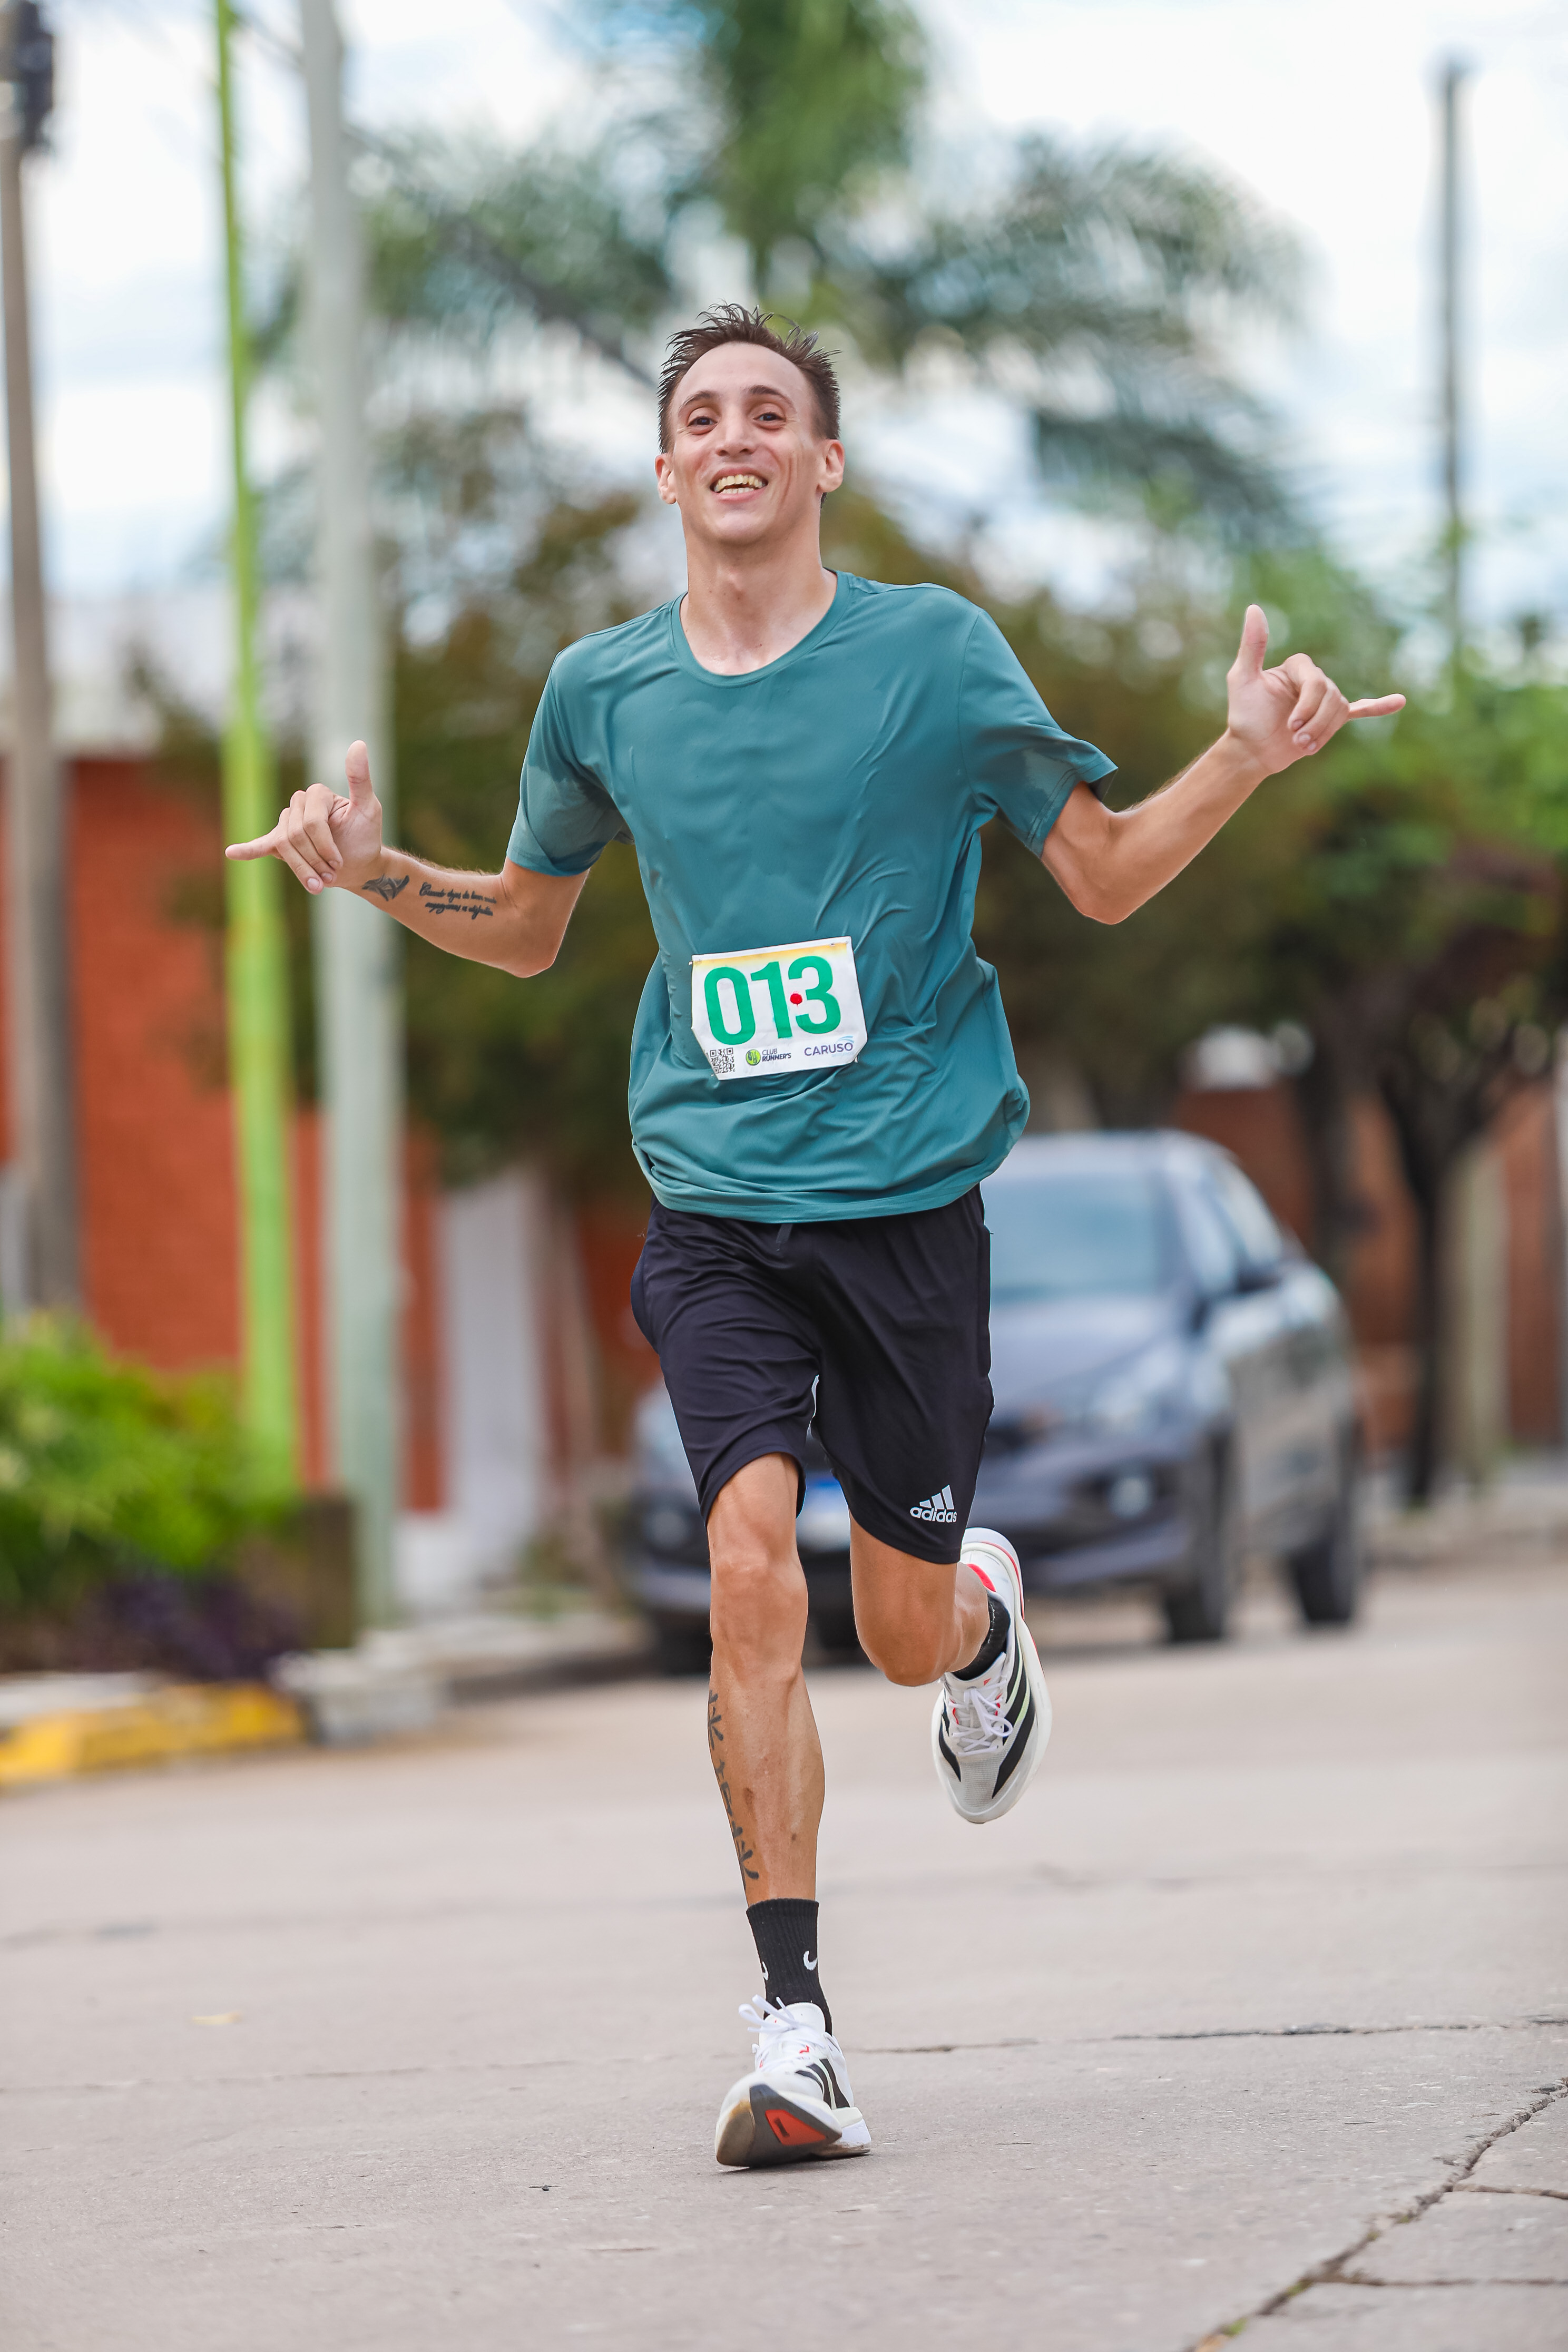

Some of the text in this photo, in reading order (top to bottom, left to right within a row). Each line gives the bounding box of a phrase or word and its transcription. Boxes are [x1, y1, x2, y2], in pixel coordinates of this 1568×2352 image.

[704, 956, 841, 1045] 013
[804, 1042, 854, 1056] CARUSO
[762, 1053, 792, 1062] RUNNER'S
[910, 1507, 957, 1523] adidas
